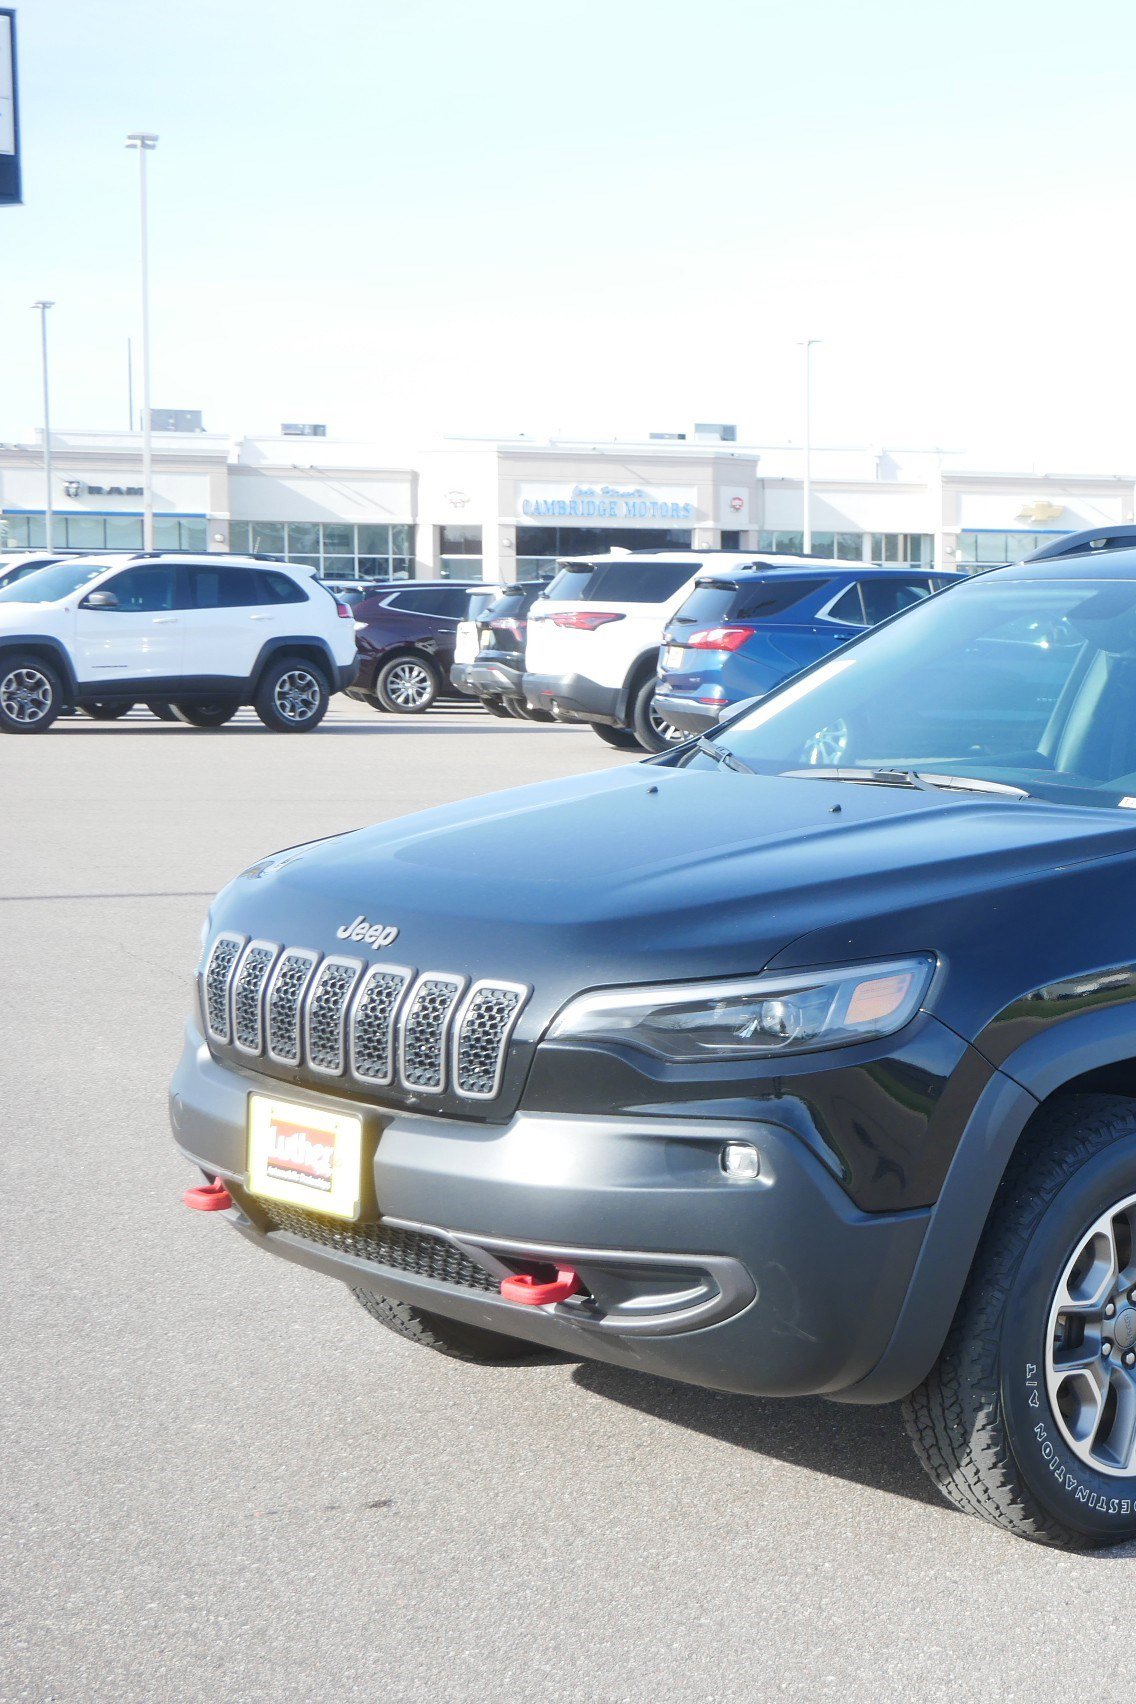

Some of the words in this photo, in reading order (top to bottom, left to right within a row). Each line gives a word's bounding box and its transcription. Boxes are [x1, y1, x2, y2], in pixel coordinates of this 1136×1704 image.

[88, 485, 144, 496] RAM
[522, 499, 618, 517] CAMBRIDGE
[624, 501, 694, 519] MOTORS
[336, 915, 399, 951] Jeep
[1025, 1363, 1040, 1408] A/T
